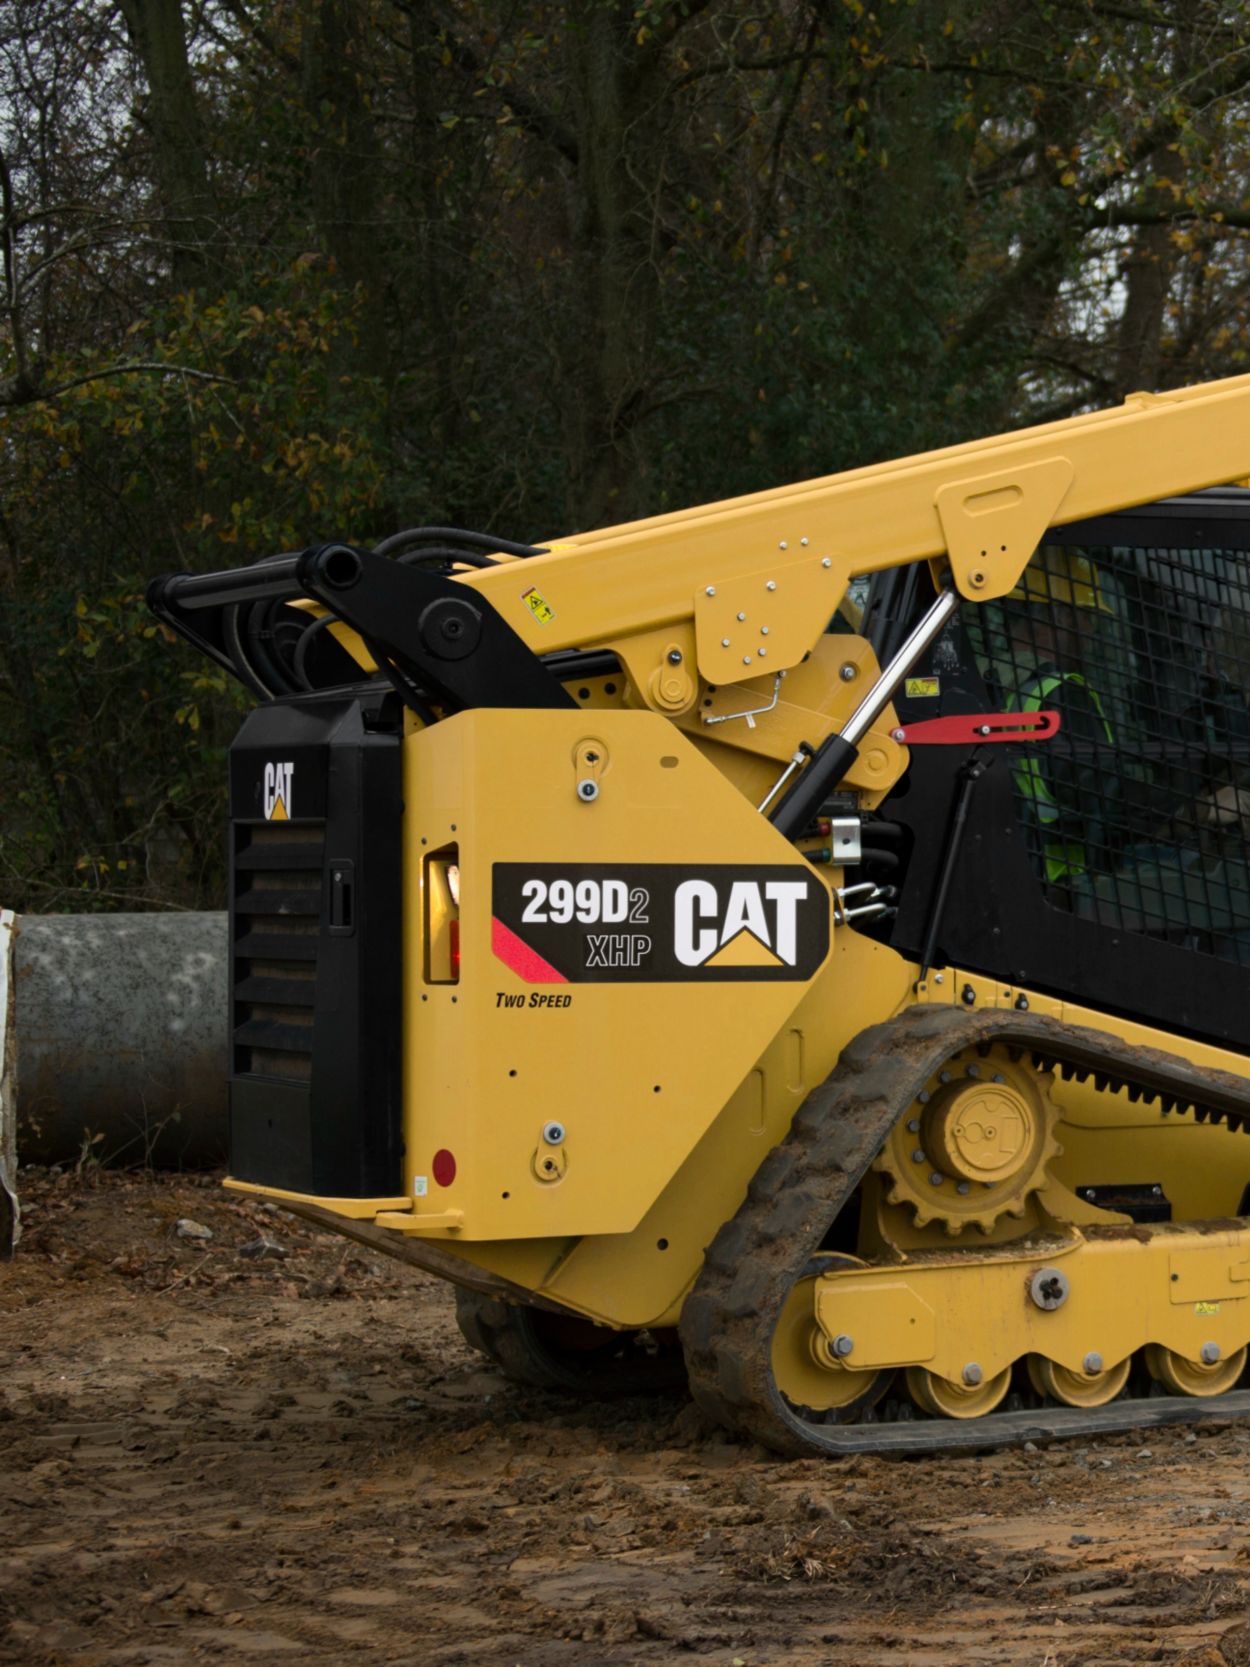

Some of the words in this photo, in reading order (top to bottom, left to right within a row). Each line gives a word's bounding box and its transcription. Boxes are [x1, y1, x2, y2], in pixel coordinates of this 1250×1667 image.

[264, 762, 294, 820] CAT
[521, 880, 649, 923] 299D2
[674, 879, 808, 967] CAT
[586, 935, 652, 966] XHP
